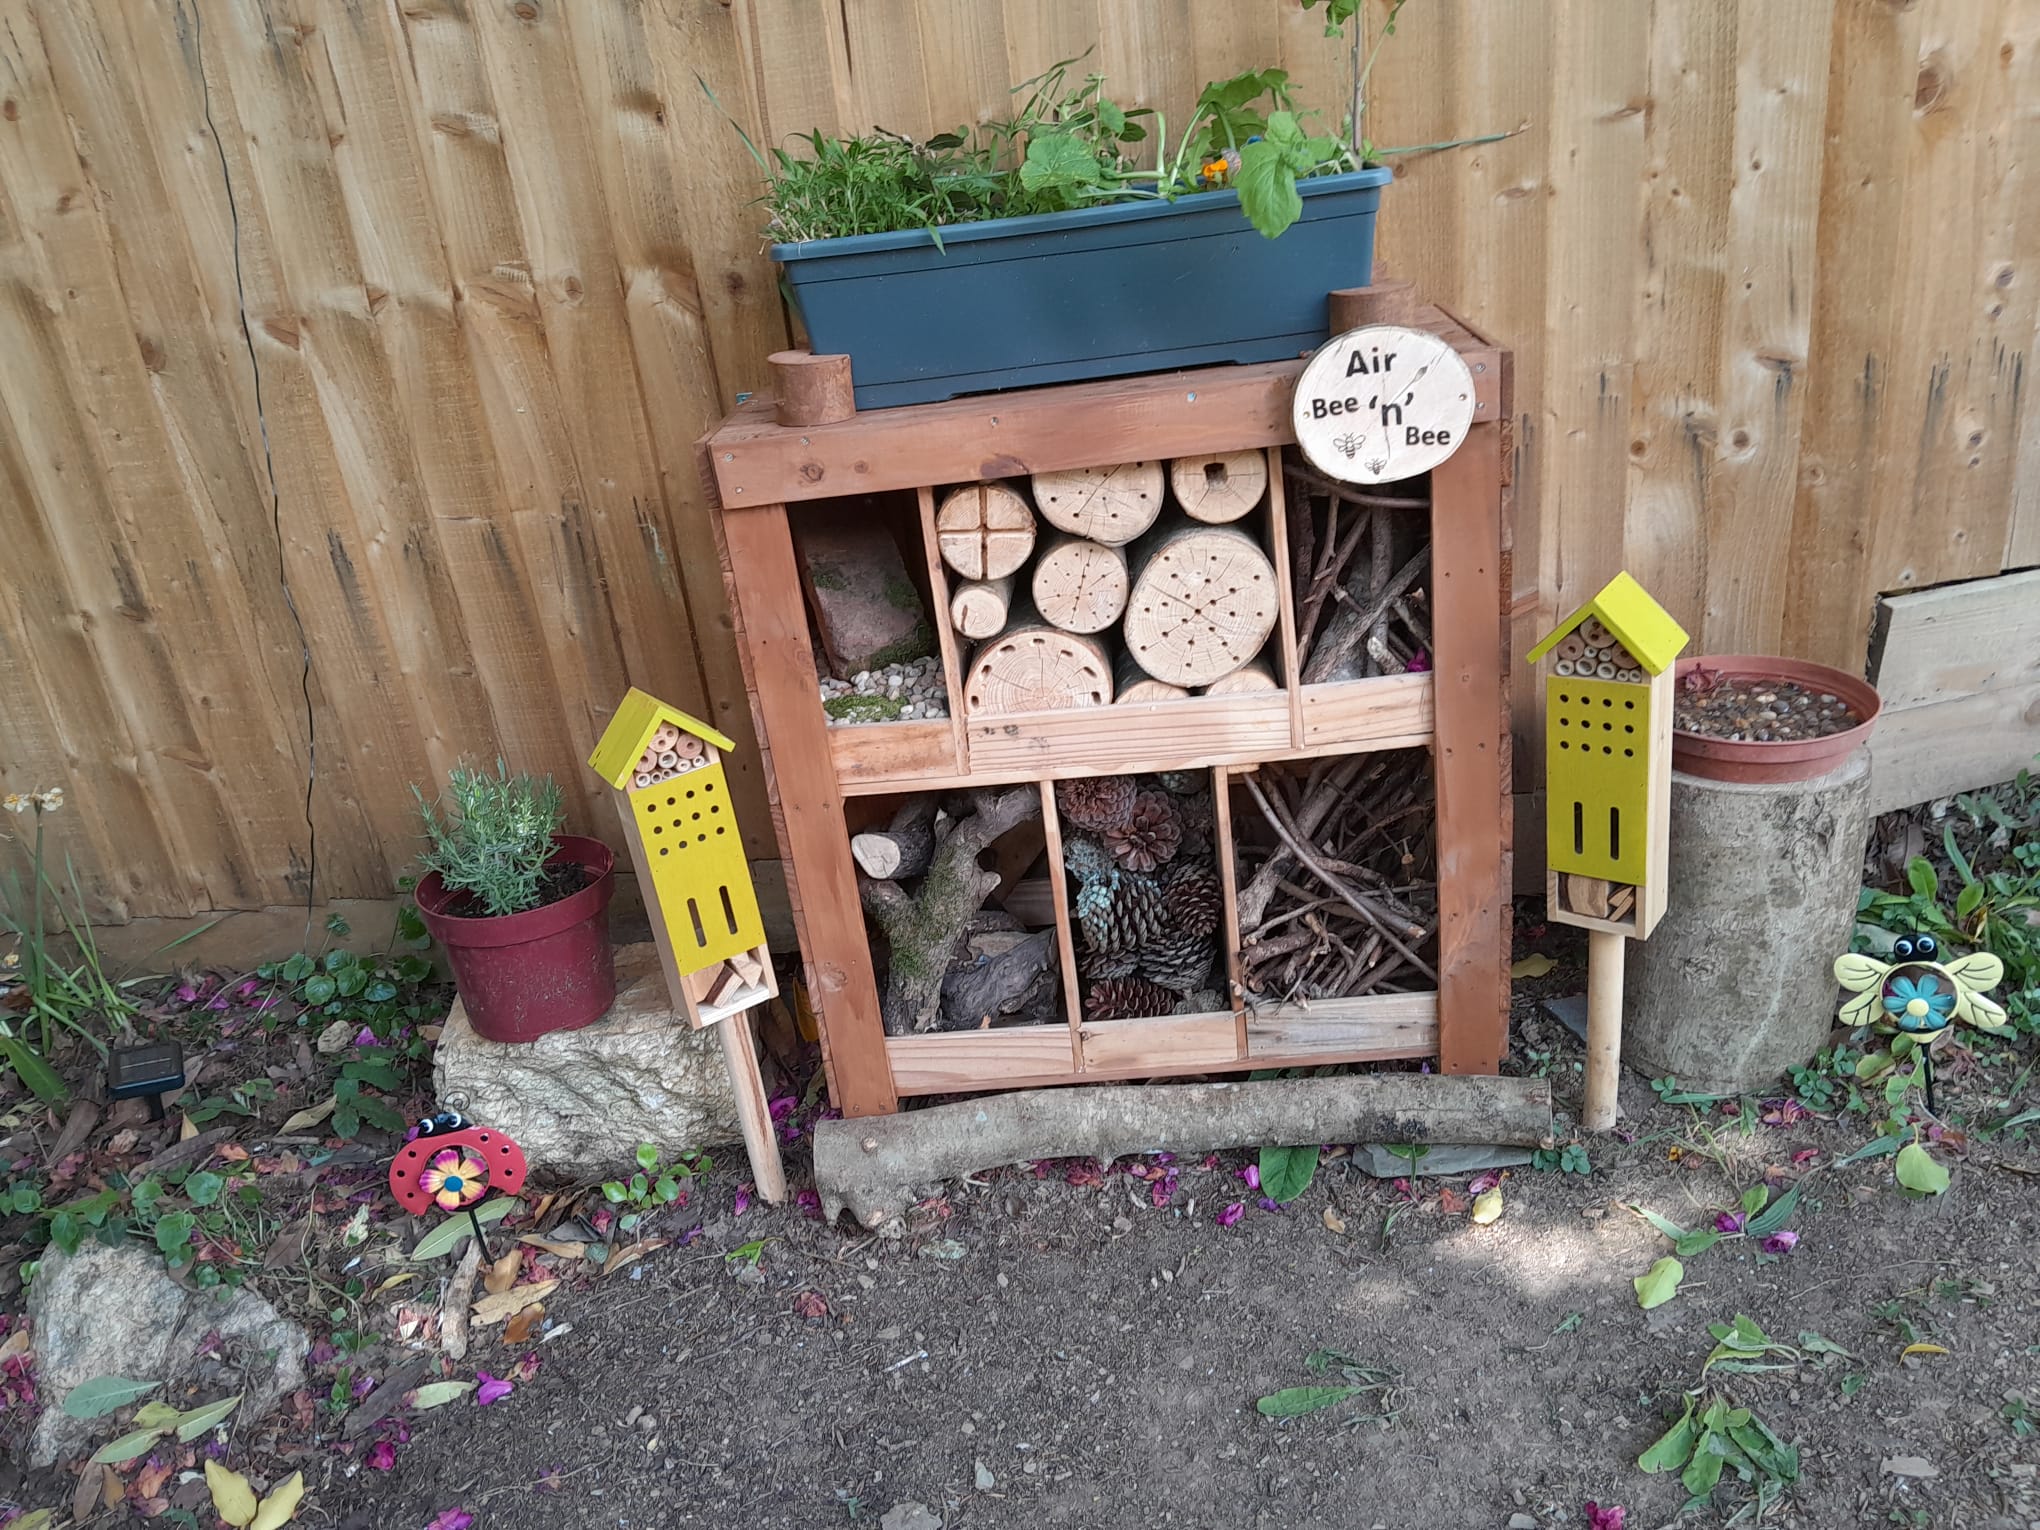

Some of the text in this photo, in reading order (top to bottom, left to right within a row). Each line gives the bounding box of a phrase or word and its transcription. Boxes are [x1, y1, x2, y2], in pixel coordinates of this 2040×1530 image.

[1345, 347, 1397, 378] Air
[1312, 396, 1359, 420] Bee
[1405, 426, 1451, 446] Bee
